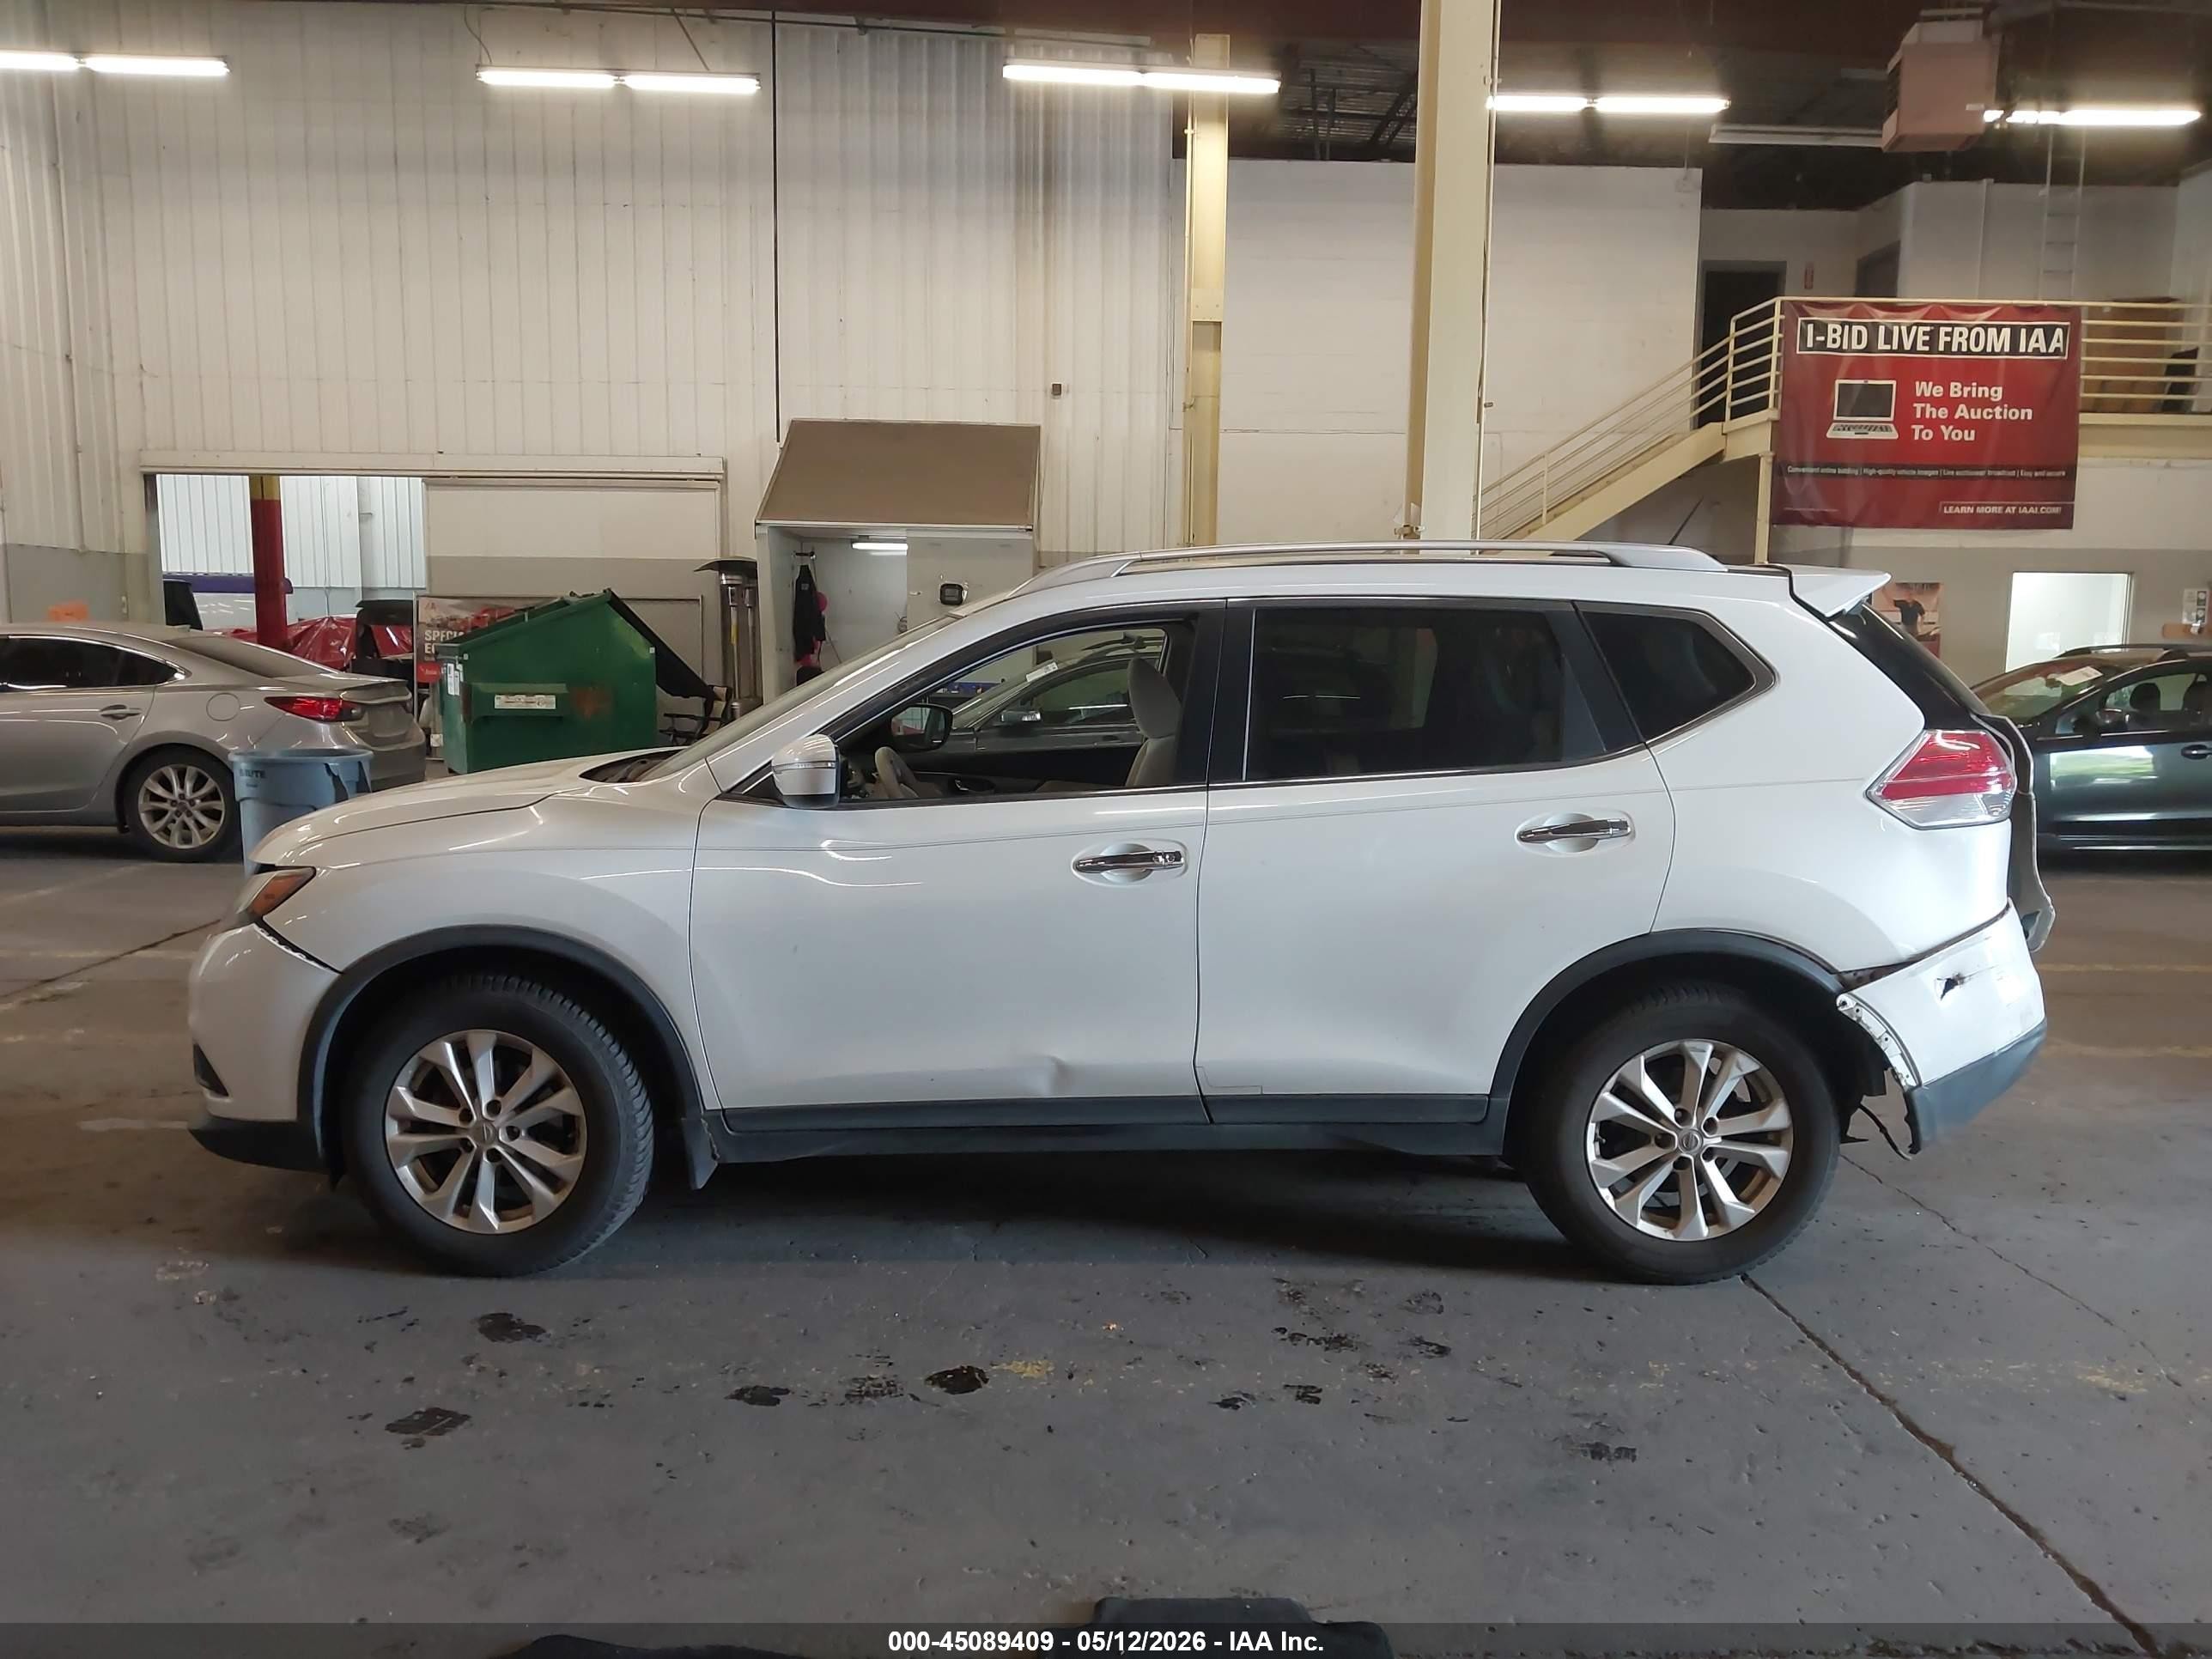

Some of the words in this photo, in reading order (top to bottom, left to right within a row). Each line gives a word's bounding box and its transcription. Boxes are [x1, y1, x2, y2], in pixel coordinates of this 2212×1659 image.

[1807, 323, 1868, 349] I-BID
[1877, 325, 1930, 351] LIVE
[1938, 326, 2010, 353] FROM
[2020, 327, 2064, 354] IAA
[1915, 381, 1943, 398] We
[1949, 381, 2003, 402] Bring
[1913, 403, 1948, 419] The
[1954, 404, 2033, 420] Auction
[1911, 424, 1933, 441] To
[1941, 425, 1976, 441] You
[1977, 506, 2003, 514] MORE
[2005, 506, 2016, 514] AT
